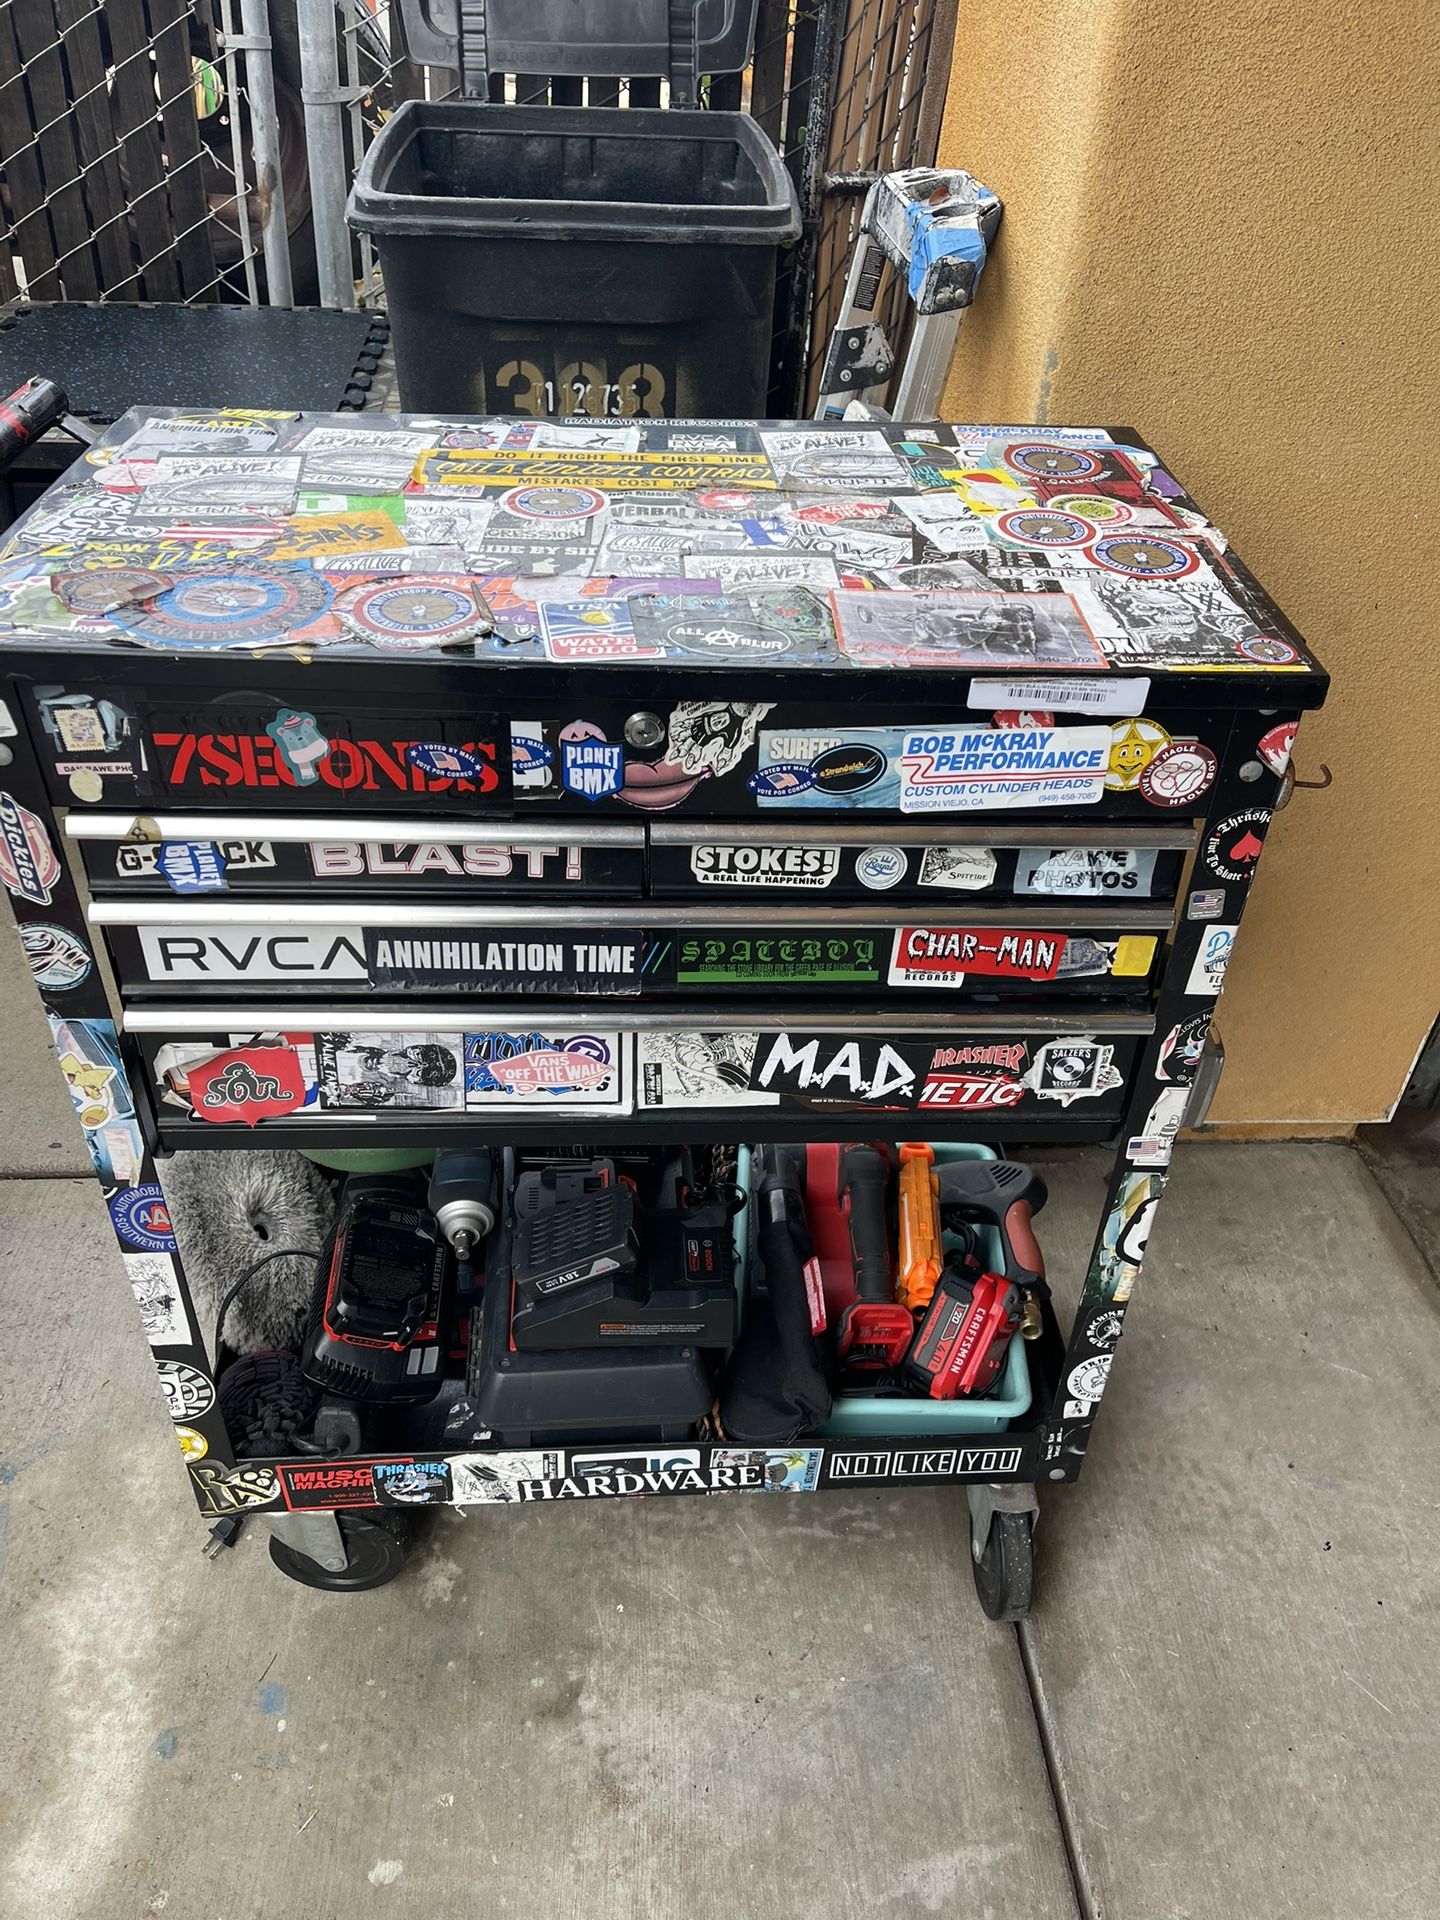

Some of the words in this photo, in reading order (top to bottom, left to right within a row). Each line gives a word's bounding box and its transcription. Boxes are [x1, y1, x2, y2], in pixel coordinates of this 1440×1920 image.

[557, 453, 607, 462] RIGHT
[619, 454, 646, 462] THE
[661, 455, 705, 463] FIRST
[719, 456, 759, 464] TIME
[435, 461, 493, 475] CALL
[492, 463, 515, 476] A
[517, 476, 606, 488] MISTAKES
[617, 479, 661, 488] COST
[610, 505, 689, 519] VERBAL
[534, 545, 561, 555] BY
[733, 562, 811, 583] ALIVE!
[568, 602, 620, 612] USA
[556, 637, 636, 648] WATE
[675, 627, 705, 636] ALL
[741, 639, 783, 650] BLUR
[569, 645, 638, 656] POLO
[527, 740, 545, 751] MAIL
[907, 736, 955, 755] BOB
[960, 732, 1054, 752] McKRAY
[1161, 745, 1197, 760] HAOLE
[423, 743, 447, 753] VOTED
[459, 750, 477, 764] MAIL
[566, 746, 620, 769] PLANET
[934, 750, 1104, 772] PERFORMANCE
[431, 767, 446, 777] POR
[446, 769, 474, 779] CORREO
[519, 758, 545, 770] CORREO
[760, 767, 781, 776] VOTED
[569, 768, 617, 795] BMX
[788, 780, 812, 794] CORREO
[904, 784, 966, 798] CUSTOM
[968, 782, 1042, 795] CYLINDER
[1044, 778, 1094, 790] HEADS
[1038, 793, 1060, 803] (949)
[1061, 791, 1098, 802] 458-7087
[1169, 780, 1210, 806] HAOLE
[903, 799, 941, 809] MISSION
[942, 799, 971, 808] VIEJO,
[971, 798, 984, 806] CA
[0, 803, 38, 893] Dickies
[164, 845, 199, 887] BMX
[187, 842, 224, 888] PLANET
[311, 842, 582, 880] BLAST!
[696, 846, 836, 874] STOKES!
[864, 858, 898, 877] Royal
[1047, 849, 1129, 868] RAWE
[713, 874, 738, 883] REAL
[741, 875, 762, 884] LIFE
[764, 876, 825, 885] HAPPENING
[947, 870, 988, 881] SPITFIRE
[1027, 869, 1139, 890] PHOTOS
[157, 936, 370, 972] RVCA
[376, 940, 563, 972] ANNIHILATION
[573, 944, 635, 974] TIME
[907, 929, 1057, 970] CHAR-MAN
[905, 973, 957, 983] RECORDS
[527, 1055, 569, 1067] VANS
[932, 1043, 1026, 1072] HRASHER
[1052, 1048, 1092, 1059] SALZER'S
[534, 1064, 560, 1082] THE
[202, 1061, 294, 1108] SOUL
[115, 1215, 165, 1251] SOUTHERN
[558, 1270, 580, 1284] 18V
[950, 1307, 988, 1375] CRAFTSMAN
[1080, 1357, 1110, 1371] TRIP
[374, 1462, 449, 1478] THRASHER
[834, 1454, 888, 1476] NOT
[898, 1452, 952, 1474] LIKE
[964, 1450, 1019, 1472] YOU
[521, 1465, 763, 1501] HARDWARE
